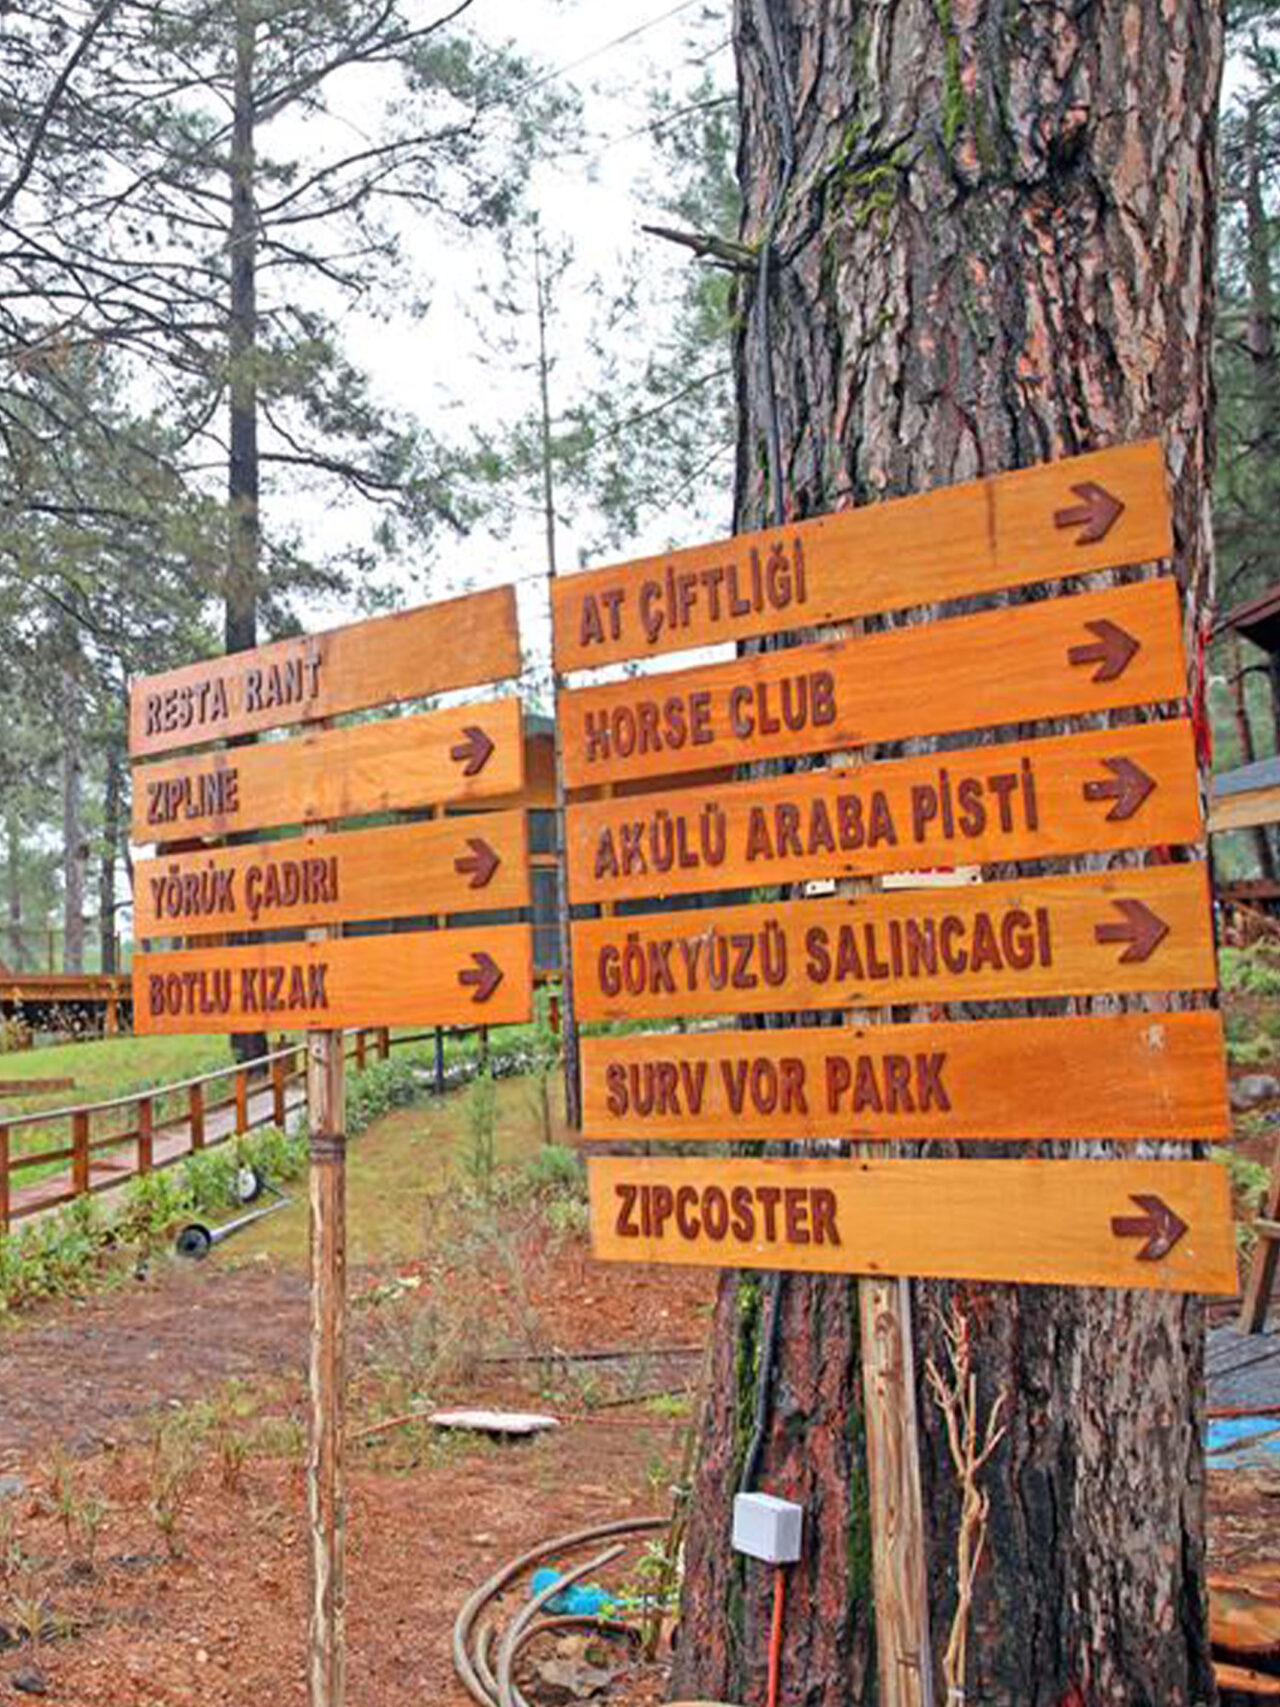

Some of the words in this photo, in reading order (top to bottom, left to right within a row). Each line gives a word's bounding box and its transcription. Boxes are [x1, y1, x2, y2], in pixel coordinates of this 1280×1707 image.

[579, 588, 624, 647] AT
[145, 676, 228, 736] RESTA
[246, 651, 322, 713] RANT
[585, 692, 714, 762] HORSE
[729, 671, 838, 740] CLUB
[147, 768, 239, 825] ZIPLINE
[594, 804, 726, 879] AKÜLÜ
[746, 789, 897, 861] ARABA
[912, 757, 1038, 842] PİSTİ
[245, 857, 338, 921] ÇADIRI
[149, 970, 230, 1016] BOTLU
[241, 963, 328, 1009] KIZAK
[598, 919, 787, 997] GÖKYÜZÜ
[825, 1053, 952, 1114] PARK
[614, 1184, 841, 1246] ZIPCOSTER
